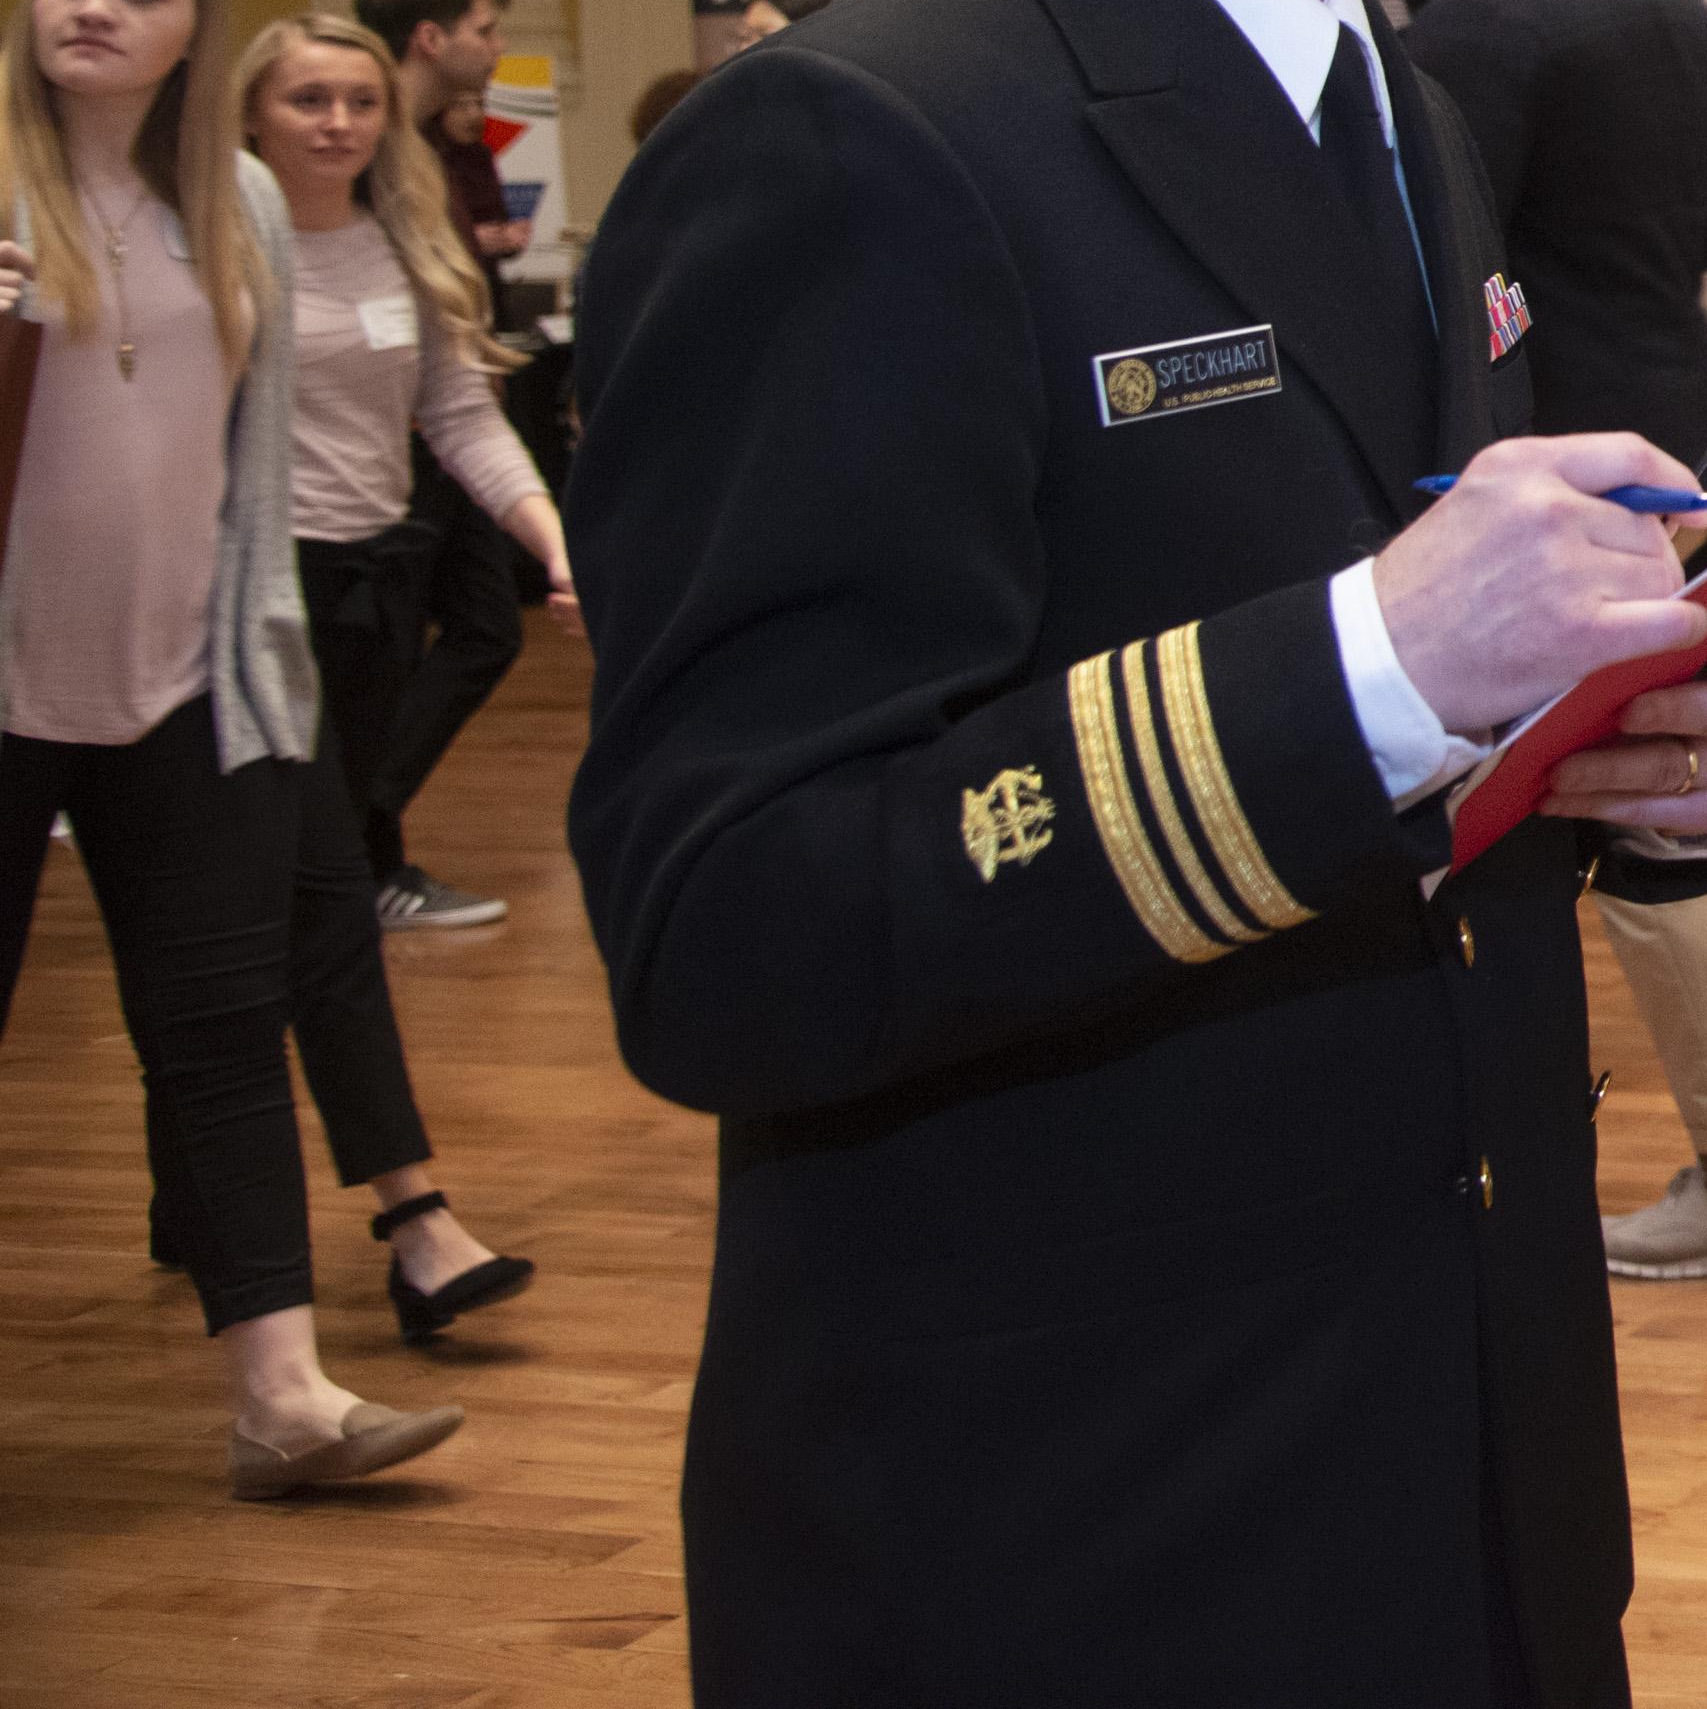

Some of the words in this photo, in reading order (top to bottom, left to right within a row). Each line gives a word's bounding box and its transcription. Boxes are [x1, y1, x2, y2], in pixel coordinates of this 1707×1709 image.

[1157, 339, 1266, 389] SPECKHART
[1181, 389, 1211, 405] PUBLIC
[1211, 383, 1242, 399] HEALTH
[1242, 376, 1277, 393] SERVICE
